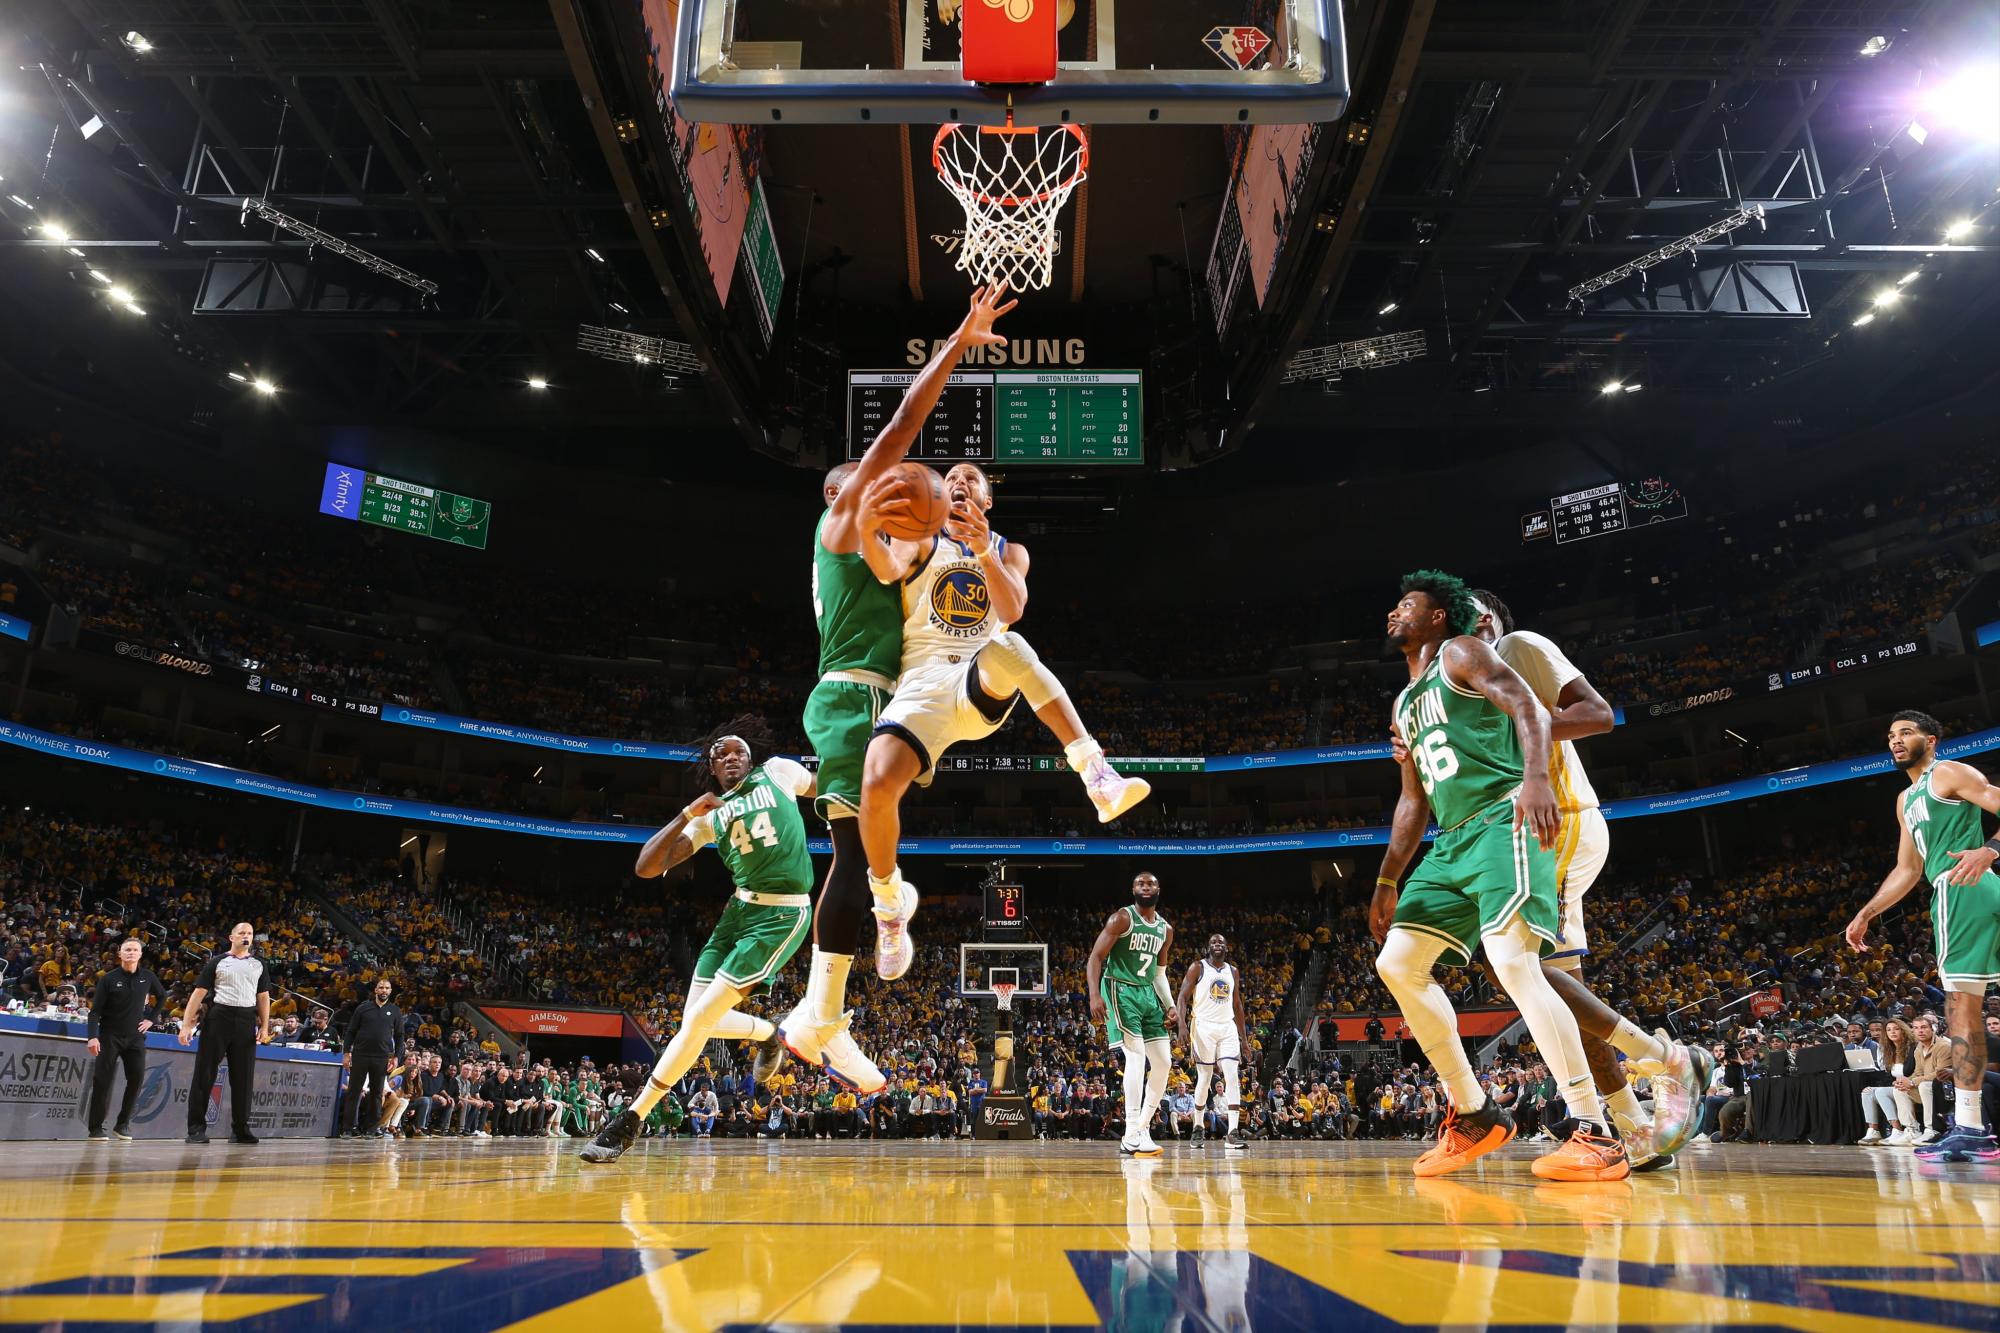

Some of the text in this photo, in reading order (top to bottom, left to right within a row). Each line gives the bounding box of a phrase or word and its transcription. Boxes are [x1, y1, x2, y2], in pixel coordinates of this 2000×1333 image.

[1242, 34, 1256, 47] 75
[881, 375, 906, 383] GOLDEN
[976, 388, 981, 396] 2
[1048, 388, 1057, 396] 17
[1122, 388, 1127, 396] 5
[976, 400, 981, 408] 9
[1051, 400, 1057, 408] 3
[1122, 400, 1127, 408] 8
[976, 412, 981, 420] 4
[1048, 412, 1057, 420] 18
[1123, 412, 1127, 420] 9
[973, 424, 981, 432] 14
[1051, 424, 1057, 432] 4
[1118, 424, 1128, 432] 20
[964, 436, 981, 444] 46.4
[1040, 436, 1057, 444] 52.0
[1112, 436, 1128, 444] 45.8
[965, 448, 981, 456] 33.3
[1042, 448, 1057, 456] 39.1
[1113, 448, 1128, 456] 72.7
[332, 470, 352, 513] xfinity
[382, 478, 425, 494] SHOT TRACKER
[1567, 486, 1610, 502] SHOT TRACKER
[381, 490, 403, 502] 22/48
[410, 497, 429, 508] 45.8%
[1571, 497, 1617, 513] 26/56 46.4%
[384, 503, 427, 518] 9/23 39.1%
[1573, 509, 1619, 525] 13/29 44.8%
[382, 514, 425, 530] 8/11 72.7%
[1525, 521, 1548, 532] TEAMS
[1532, 516, 1542, 524] MY
[1580, 520, 1621, 535] 1/3 33.3%
[935, 561, 985, 577] GOLDEN STA
[966, 584, 985, 601] 30
[929, 613, 989, 638] WARRIORS
[158, 653, 212, 675] BLOODED
[1791, 642, 1916, 680] EDM 0 COL 3 P3 10:20
[271, 683, 288, 693] EDM
[292, 688, 297, 697] 0
[311, 694, 327, 704] COL
[332, 699, 336, 707] 3
[359, 704, 378, 714] 10:20
[1685, 687, 1733, 709] BLOODED
[460, 722, 589, 749] HIRE ANYONE, ANYWHERE. TODAY.
[15, 731, 71, 751] ANYWHERE.
[75, 745, 110, 759] TODAY.
[957, 760, 967, 768] 66
[995, 758, 1011, 766] 7:38
[1040, 760, 1049, 768] 61
[1412, 729, 1459, 795] 36
[1851, 740, 1981, 773] No entity? Use the #1
[235, 778, 317, 799] globalization-partners.com
[1650, 790, 1730, 809] globalization-partners.com
[717, 785, 777, 832] BOSTON
[441, 812, 462, 821] entity?
[474, 816, 501, 825] problem.
[536, 824, 555, 833] global
[556, 827, 593, 836] employment
[594, 830, 628, 839] technology.
[730, 811, 779, 855] 44
[1235, 841, 1271, 849] employment
[1272, 839, 1304, 847] technology.
[997, 889, 1018, 899] 7:37
[1005, 900, 1016, 917] 6
[1129, 933, 1164, 955] BOSTON
[1137, 953, 1153, 977] 7
[1752, 995, 1780, 1006] JAMESON
[529, 1012, 568, 1024] JAMESON
[270, 1071, 307, 1087] GAME 2
[0, 1084, 78, 1099] NFERENCE FINAL
[174, 1088, 188, 1103] VS
[251, 1091, 299, 1107] MORROW
[46, 1108, 67, 1118] 2022
[282, 1112, 317, 1128] ESPN+
[989, 1108, 1025, 1125] Finals
